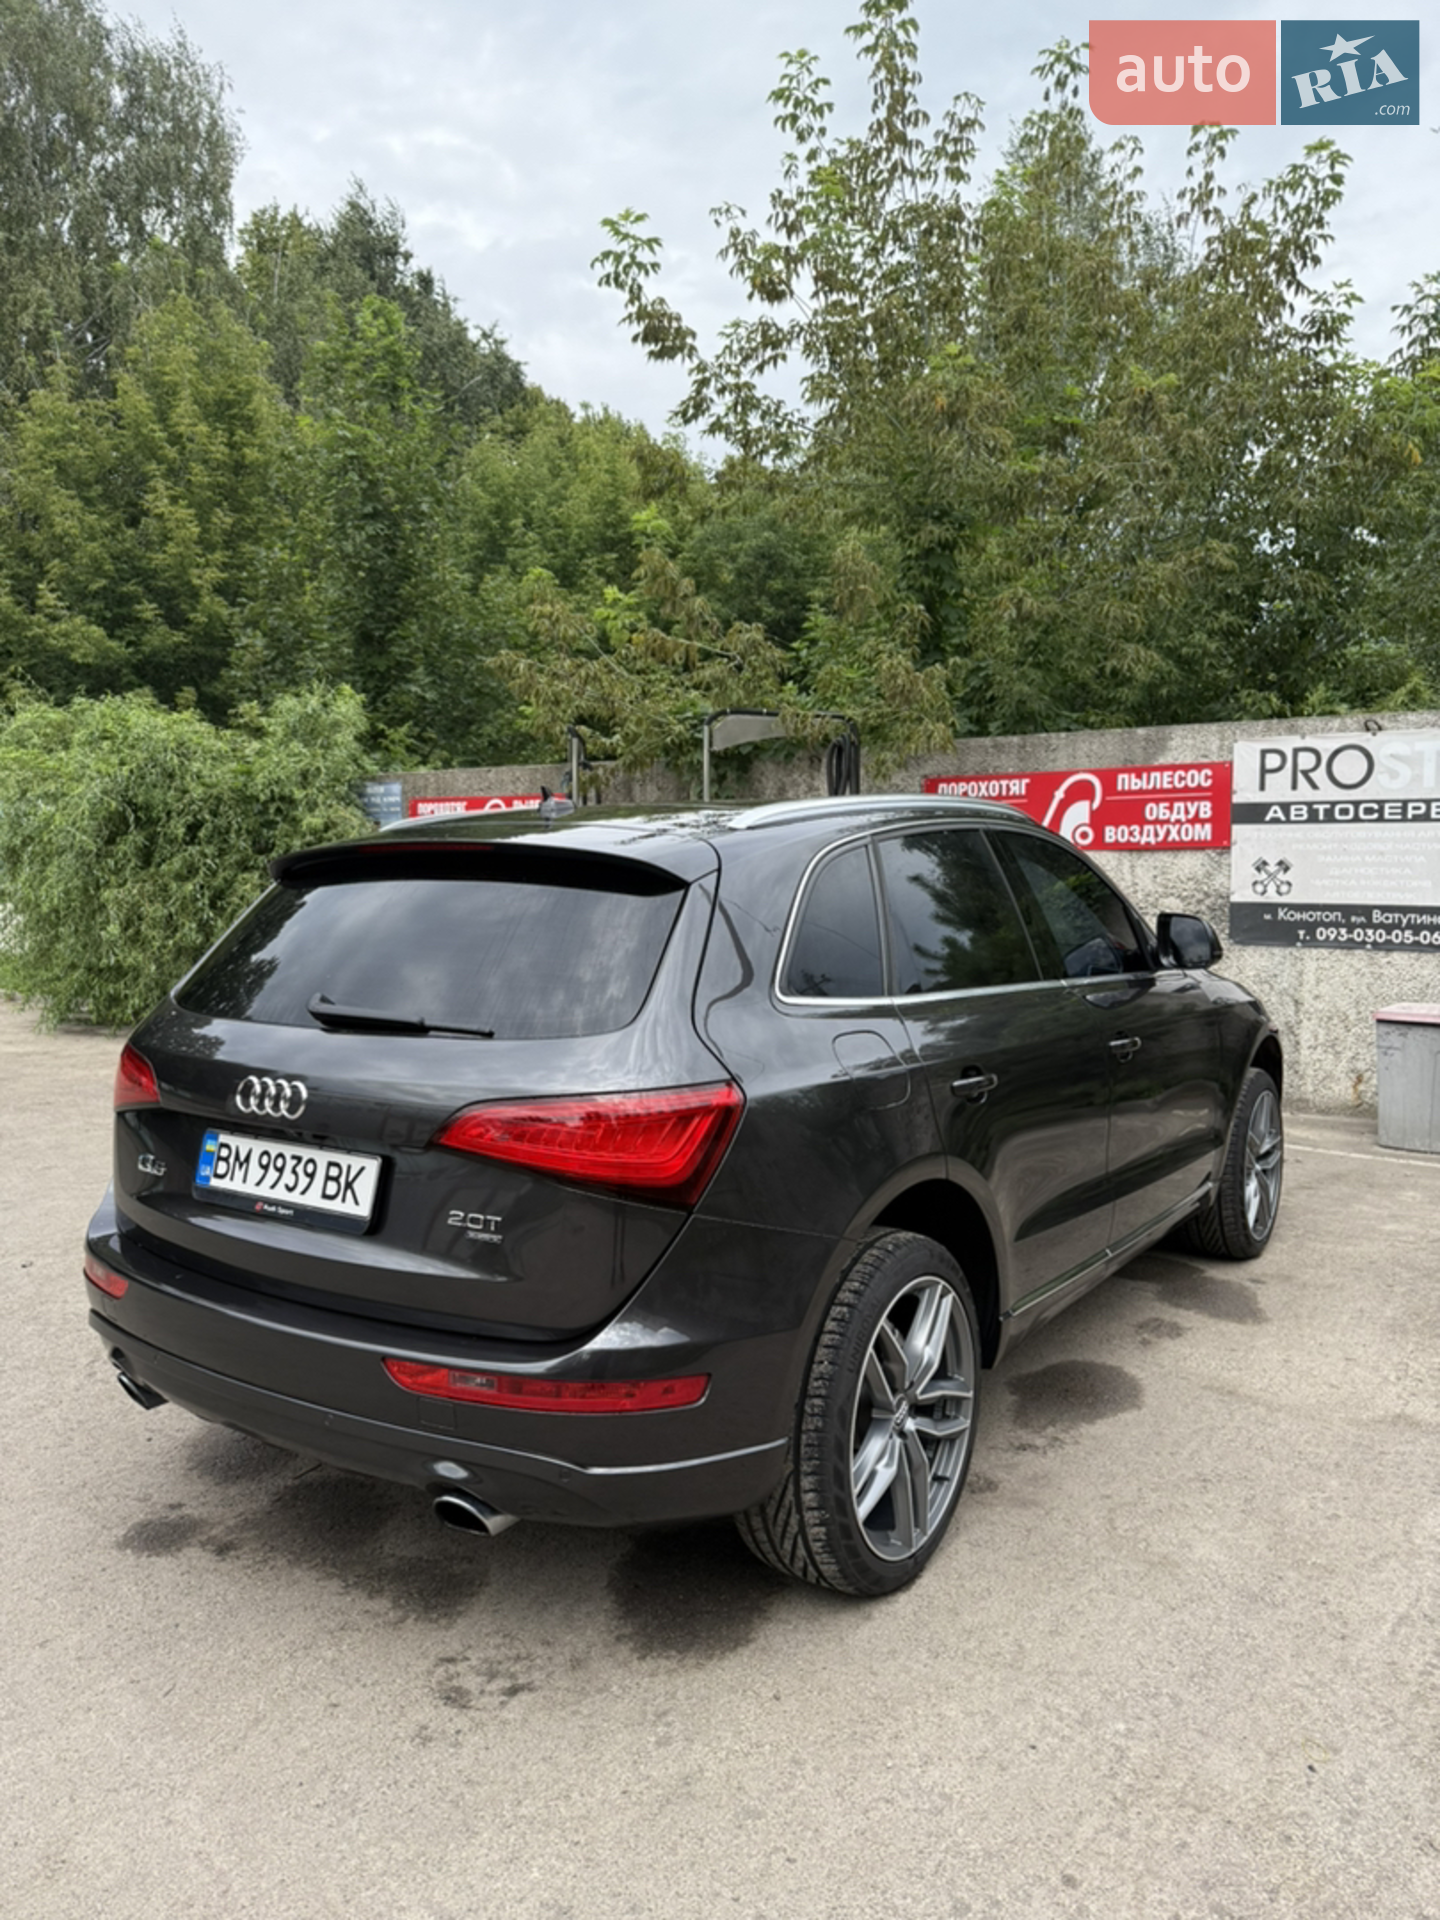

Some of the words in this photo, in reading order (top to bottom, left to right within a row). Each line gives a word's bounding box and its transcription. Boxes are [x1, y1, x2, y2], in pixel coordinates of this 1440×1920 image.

[937, 778, 1031, 798] ПОРОХОТЯГ
[1116, 769, 1213, 791] ПЫЛЕСОС
[1144, 802, 1213, 823] ОБДУВ
[1104, 824, 1213, 845] ВОЗДУХОМ
[1277, 907, 1346, 924] Конотоп,
[1297, 929, 1311, 941] т.
[1315, 926, 1440, 945] 093-030-05-06
[212, 1142, 253, 1184] BM
[254, 1149, 318, 1196] 9939
[320, 1160, 366, 1207] BK
